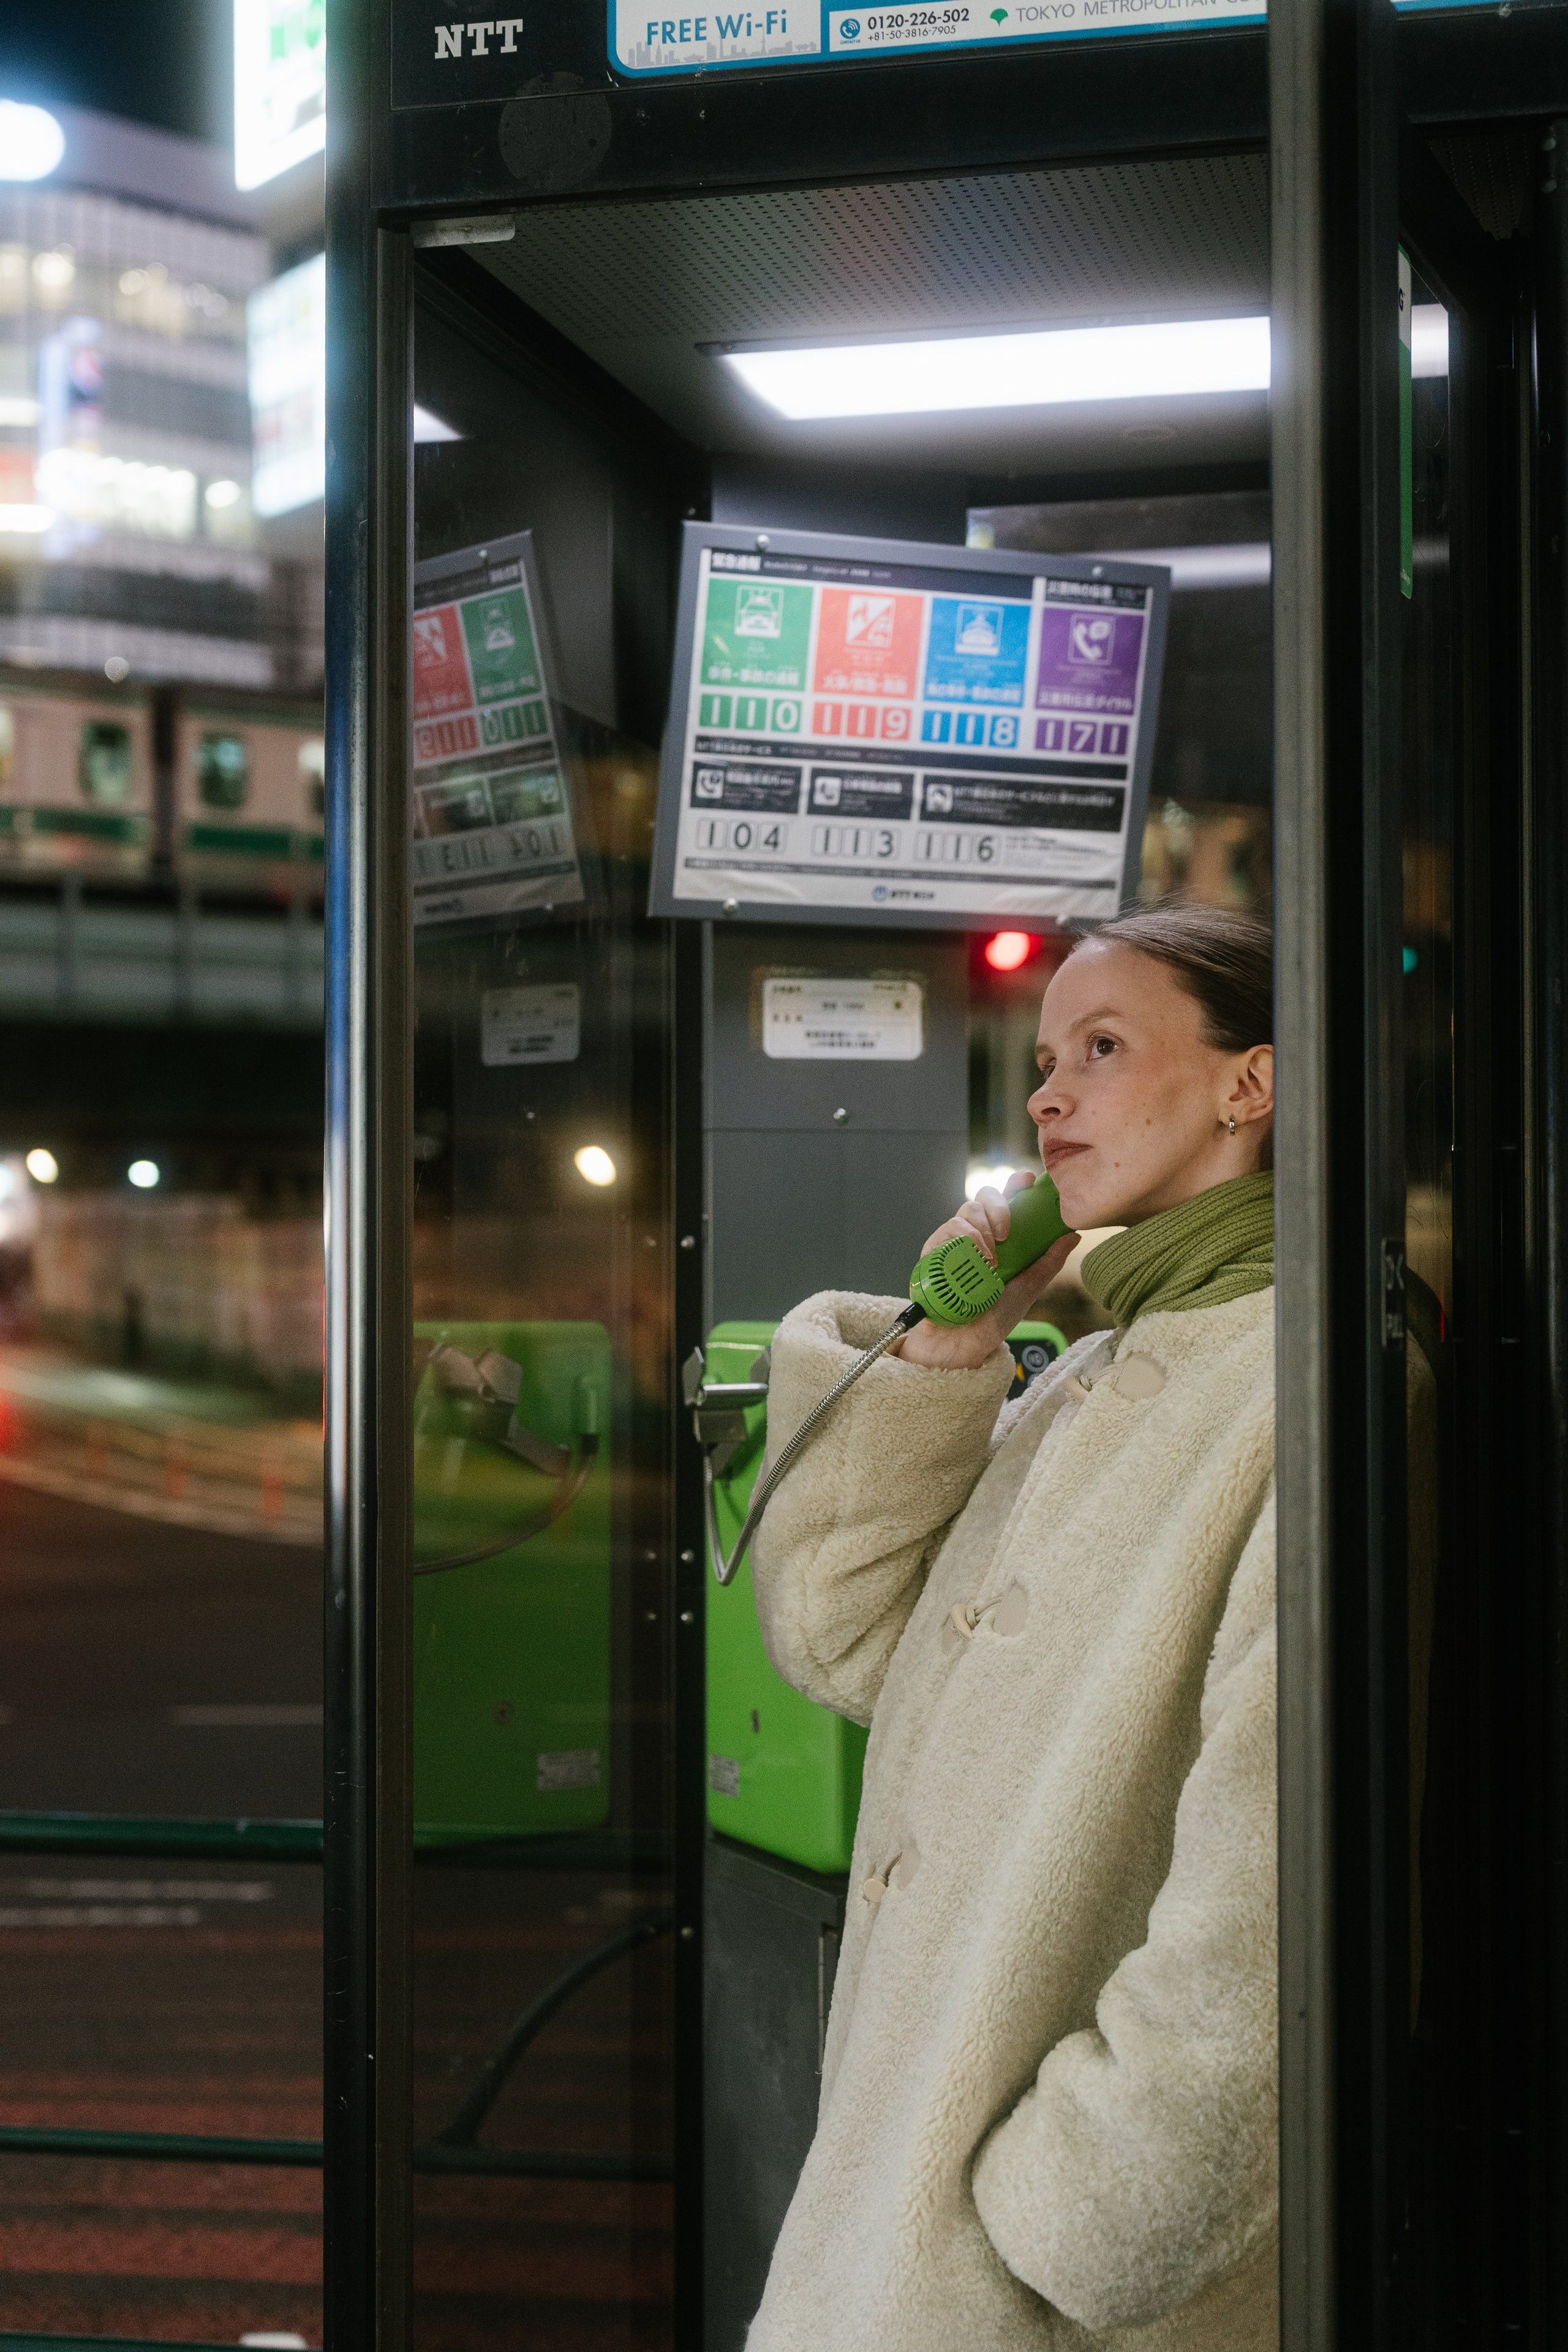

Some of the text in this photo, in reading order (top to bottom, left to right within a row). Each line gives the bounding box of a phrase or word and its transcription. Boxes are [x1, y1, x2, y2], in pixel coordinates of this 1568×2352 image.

[647, 9, 786, 45] FREE Wi-Fi
[867, 8, 970, 29] 0120-226-502
[1016, 4, 1075, 21] TOKYO
[435, 19, 523, 59] NTT
[867, 25, 956, 41] +81-50-3816-7905
[710, 696, 799, 731] 110
[823, 704, 908, 738] 119
[931, 712, 1015, 747] 118
[1045, 720, 1119, 753] 171
[709, 822, 780, 851] 104
[824, 827, 894, 858] 113
[926, 832, 994, 862] 116
